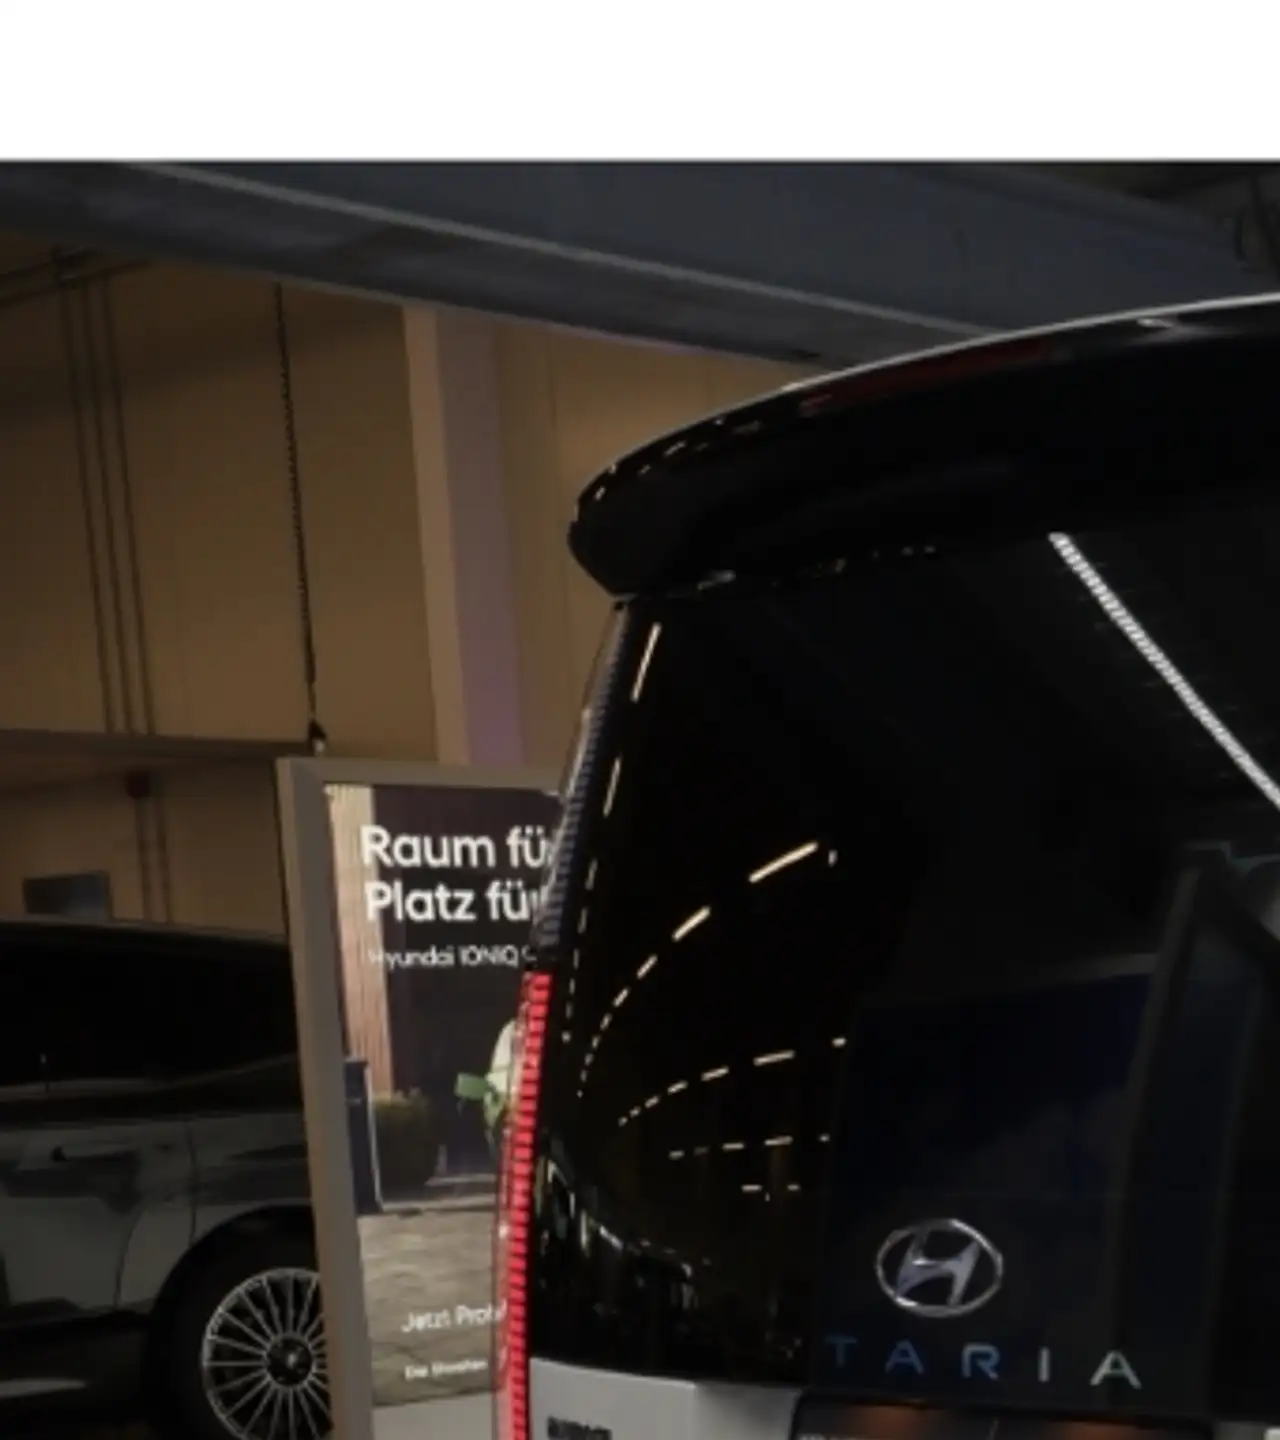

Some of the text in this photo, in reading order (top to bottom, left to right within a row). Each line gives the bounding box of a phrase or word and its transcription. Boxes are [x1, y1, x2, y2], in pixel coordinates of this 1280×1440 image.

[361, 825, 553, 868] Raum fü
[365, 880, 477, 922] Platz
